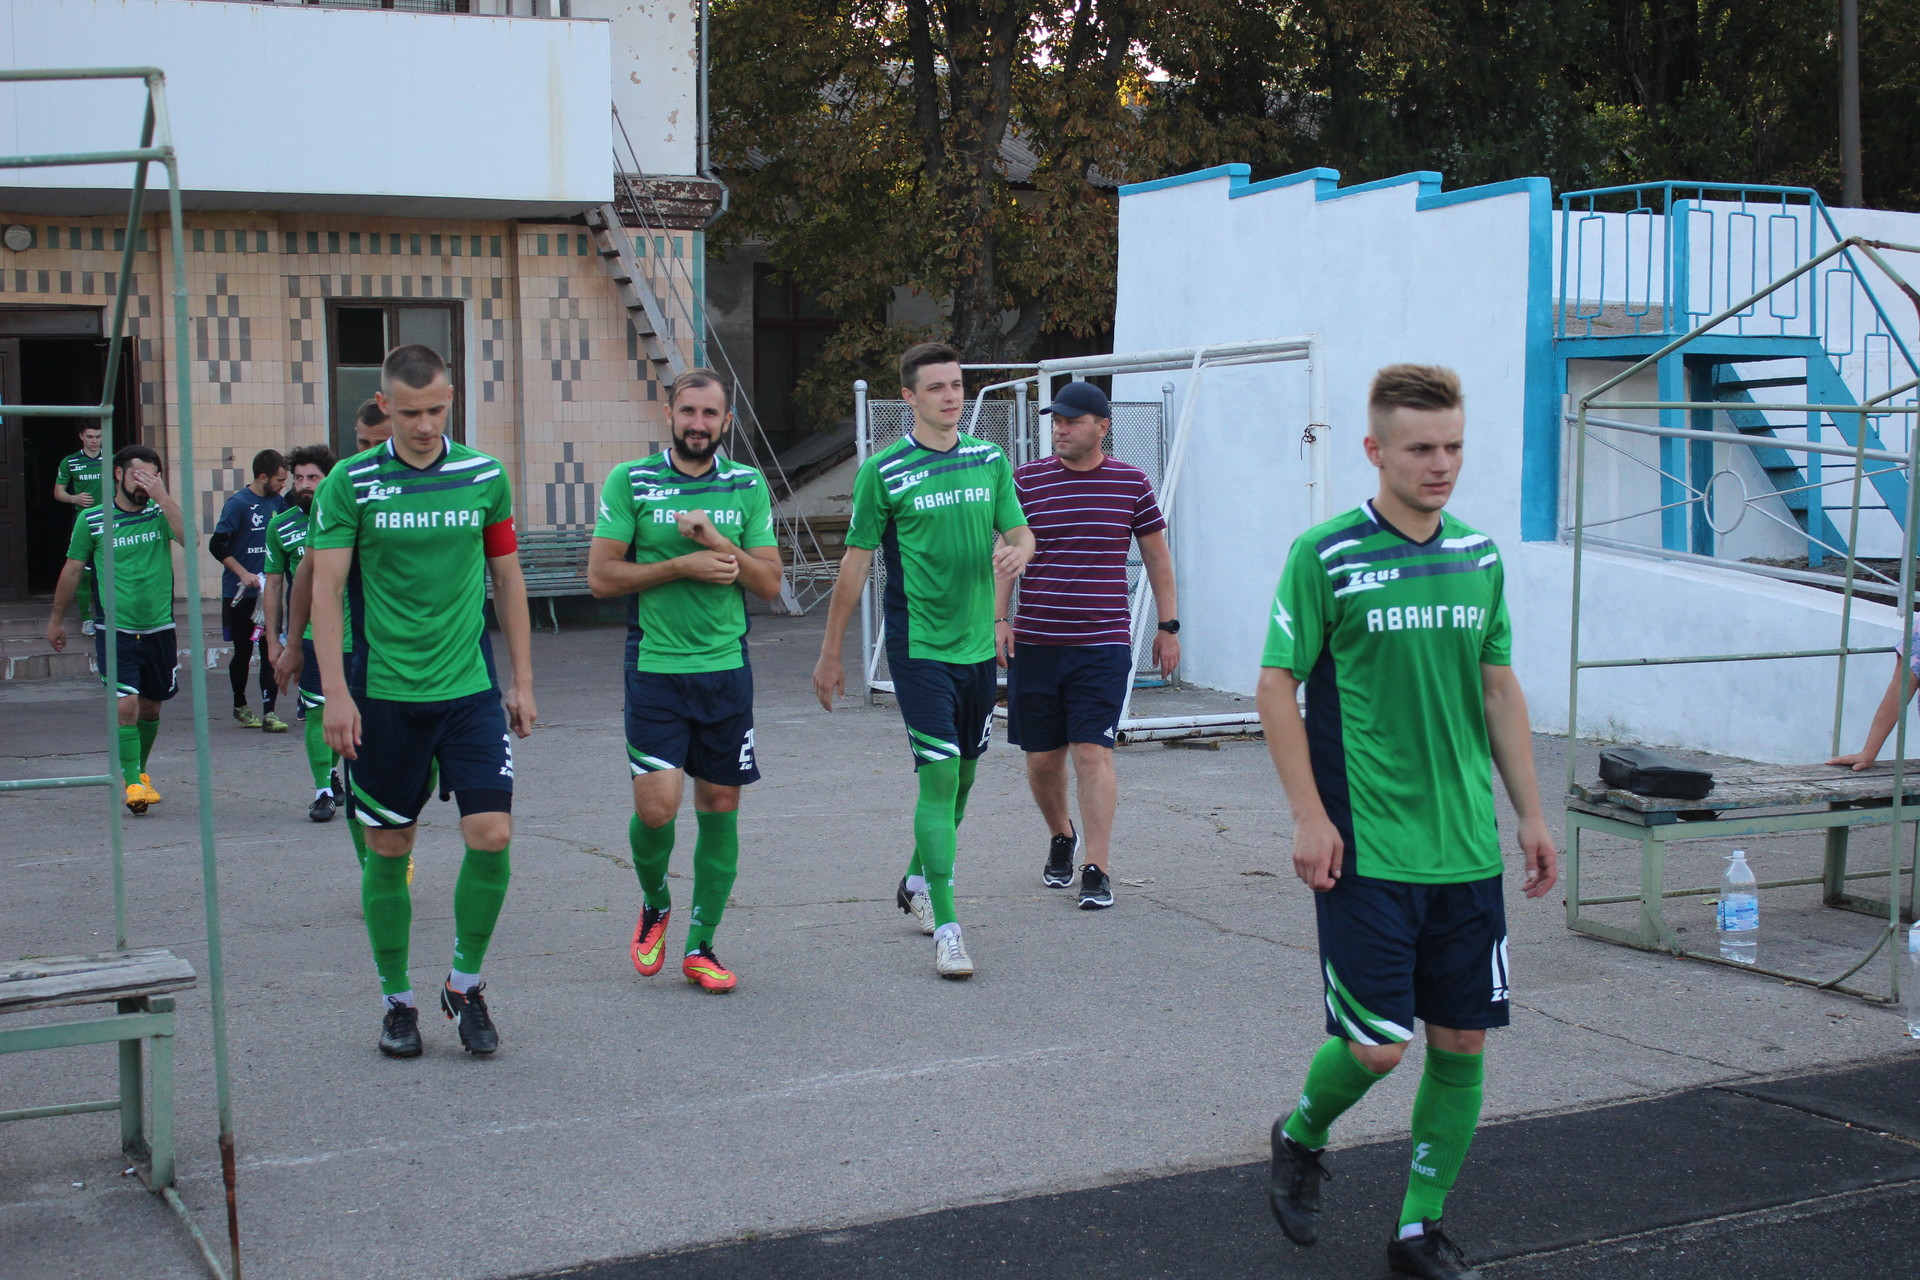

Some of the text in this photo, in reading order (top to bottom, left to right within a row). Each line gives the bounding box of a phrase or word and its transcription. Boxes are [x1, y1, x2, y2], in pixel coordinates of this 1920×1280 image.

[79, 473, 104, 481] АВАНГ
[902, 470, 929, 484] Zeus
[368, 485, 402, 496] Zeus
[647, 488, 680, 497] Zeus
[914, 487, 991, 511] АВАНГАРД
[375, 510, 480, 529] АВАНГАРД
[290, 530, 307, 542] Zeu
[1348, 568, 1400, 587] Zeus
